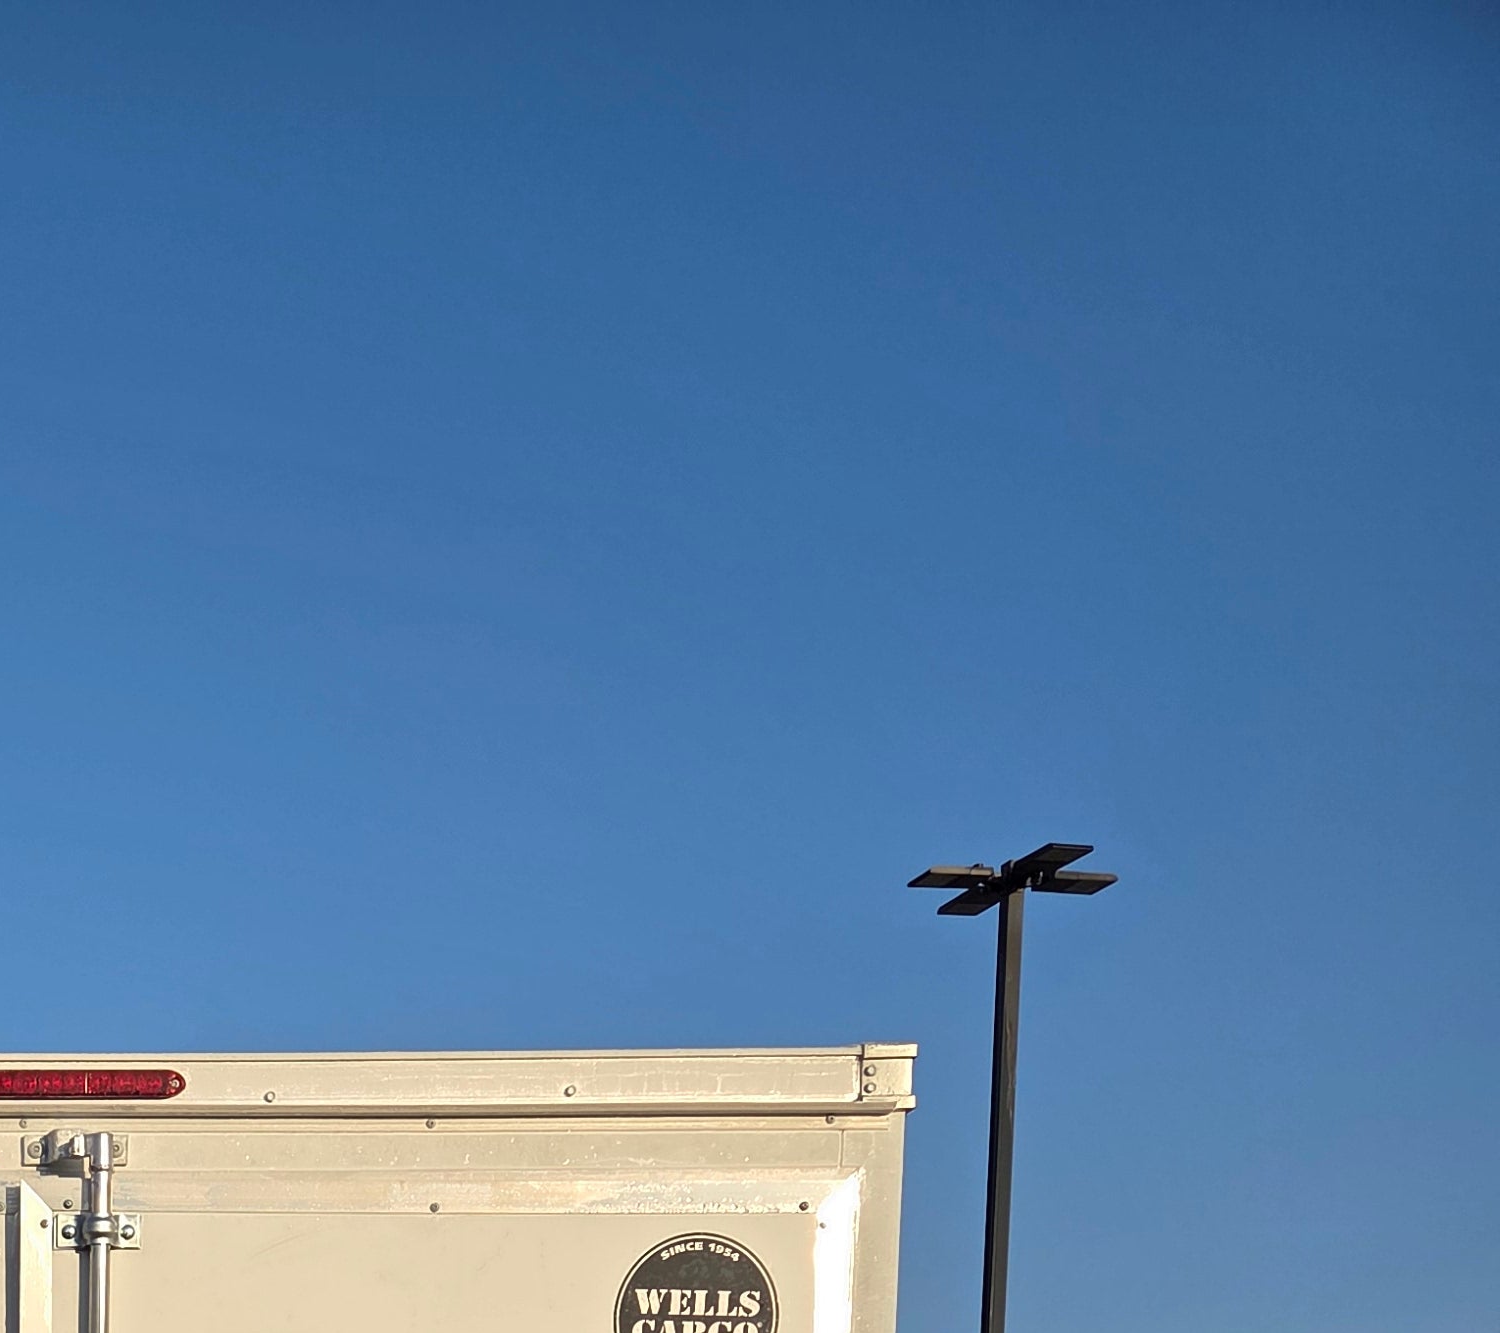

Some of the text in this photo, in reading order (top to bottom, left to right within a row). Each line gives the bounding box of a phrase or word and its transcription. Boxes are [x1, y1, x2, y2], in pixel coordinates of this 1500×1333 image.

[660, 1241, 740, 1262] SINCE 1954
[634, 1288, 761, 1318] WELLS
